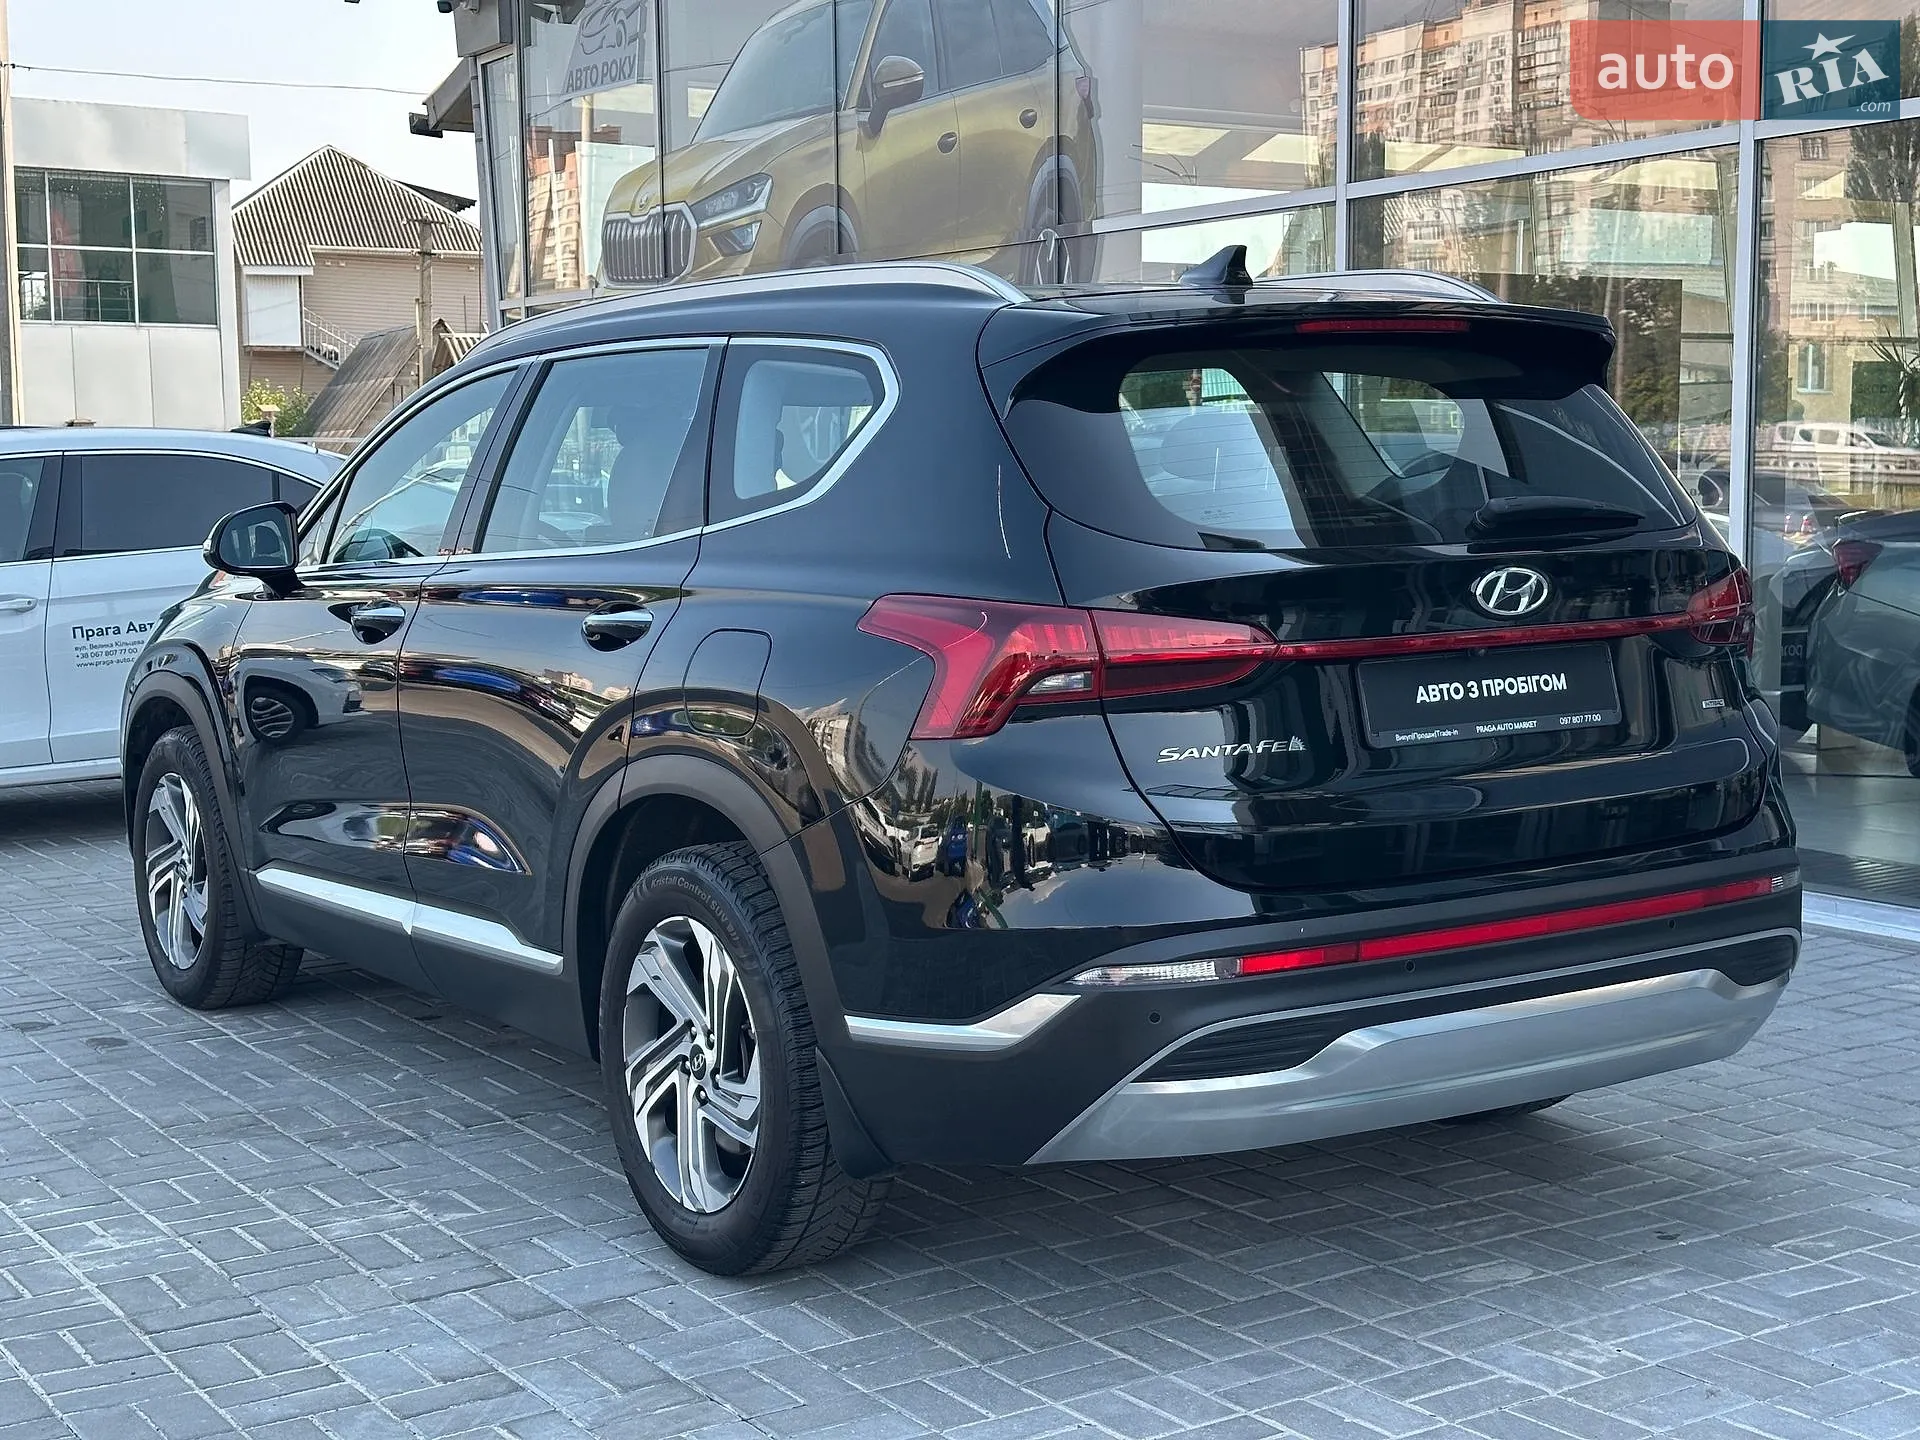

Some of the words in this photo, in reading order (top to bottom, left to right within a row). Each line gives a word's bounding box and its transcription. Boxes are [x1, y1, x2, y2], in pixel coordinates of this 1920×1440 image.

[566, 64, 599, 93] АВТО
[601, 54, 637, 84] РОКУ
[72, 626, 121, 641] Прага
[126, 621, 155, 634] Авт
[90, 650, 103, 658] 067
[105, 649, 118, 657] 807
[76, 657, 135, 668] www.praga-auto.c
[1416, 682, 1465, 704] АВТО
[1466, 680, 1480, 699] З
[1481, 672, 1568, 698] ПРОБІГОМ
[1559, 716, 1571, 725] 097
[1572, 715, 1584, 724] 807
[1584, 714, 1592, 722] 77
[1592, 713, 1602, 721] 00
[1475, 724, 1497, 733] PRAGA
[1497, 721, 1514, 731] AUTO
[1514, 720, 1537, 729] MARKET
